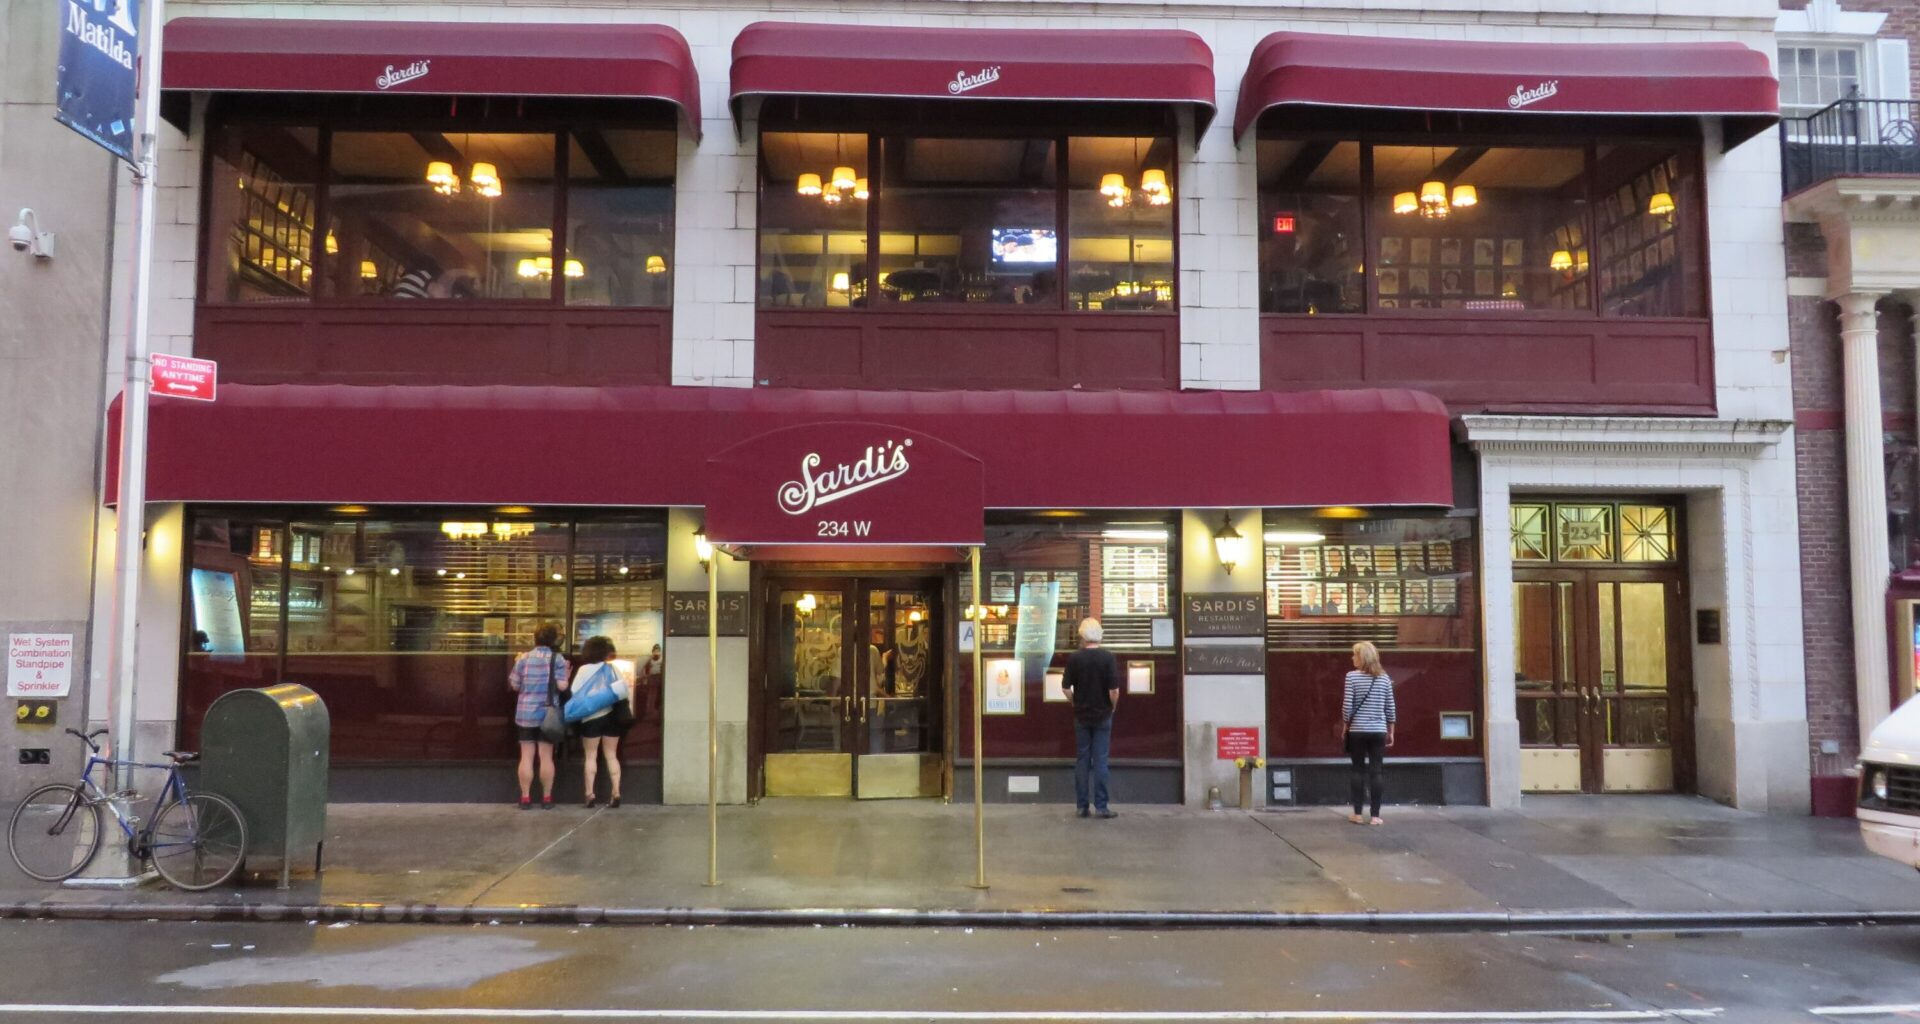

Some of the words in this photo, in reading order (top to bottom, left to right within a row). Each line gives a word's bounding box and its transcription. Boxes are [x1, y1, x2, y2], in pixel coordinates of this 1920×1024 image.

[66, 2, 133, 70] Matilda
[376, 60, 430, 90] Sardi's
[948, 66, 1000, 95] Sardi's
[1508, 80, 1558, 109] Sardi's
[155, 358, 168, 367] NO
[171, 360, 213, 373] STANDING
[161, 370, 206, 383] ANYTIME
[778, 439, 910, 515] Sardi's
[817, 521, 849, 537] 234
[853, 521, 872, 537] W
[1571, 526, 1600, 540] 234
[963, 626, 974, 642] A
[13, 637, 32, 646] Wet
[35, 637, 70, 648] System
[10, 648, 71, 657] Combination
[15, 659, 65, 669] Standpipe
[35, 671, 43, 679] &
[16, 681, 60, 691] Sprinkler
